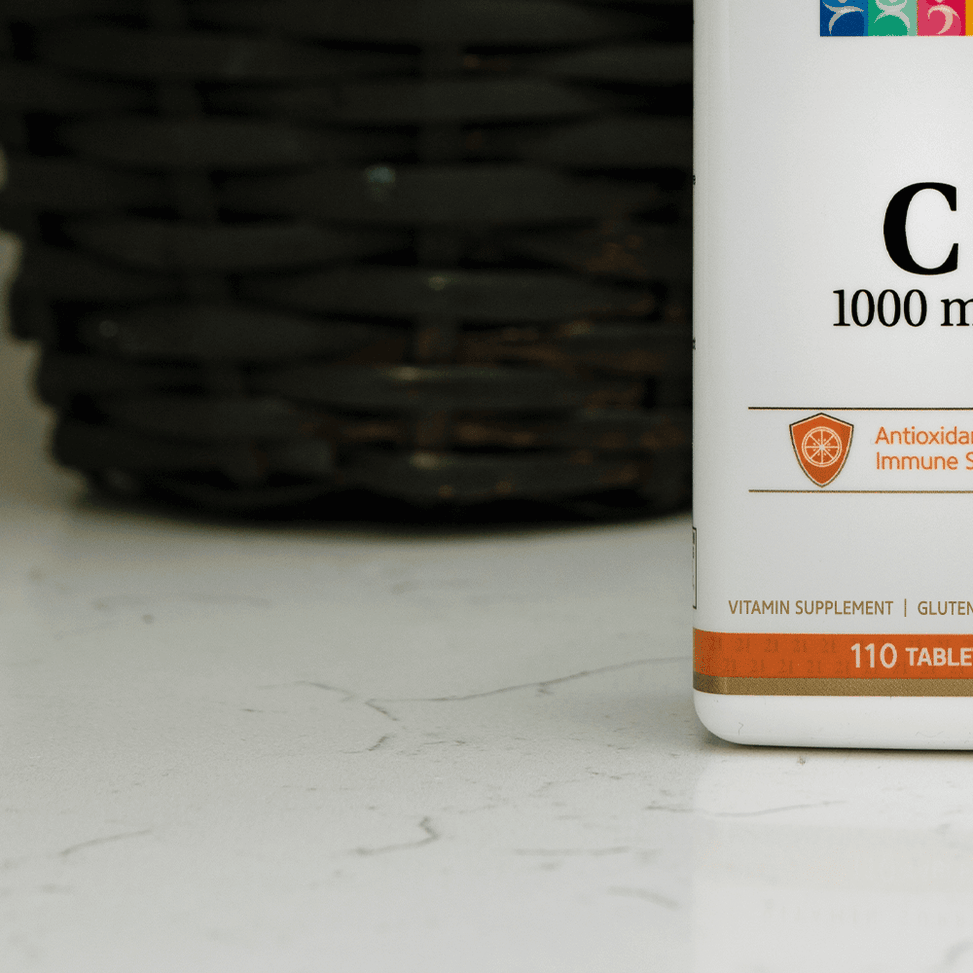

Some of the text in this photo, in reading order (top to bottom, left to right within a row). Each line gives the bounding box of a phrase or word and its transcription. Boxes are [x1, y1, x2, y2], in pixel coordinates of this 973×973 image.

[883, 181, 959, 276] C
[832, 288, 928, 328] 1000
[875, 450, 959, 471] Immune
[727, 599, 790, 615] VITAMIN
[795, 599, 895, 616] SUPPLEMENT
[850, 642, 898, 669] 110
